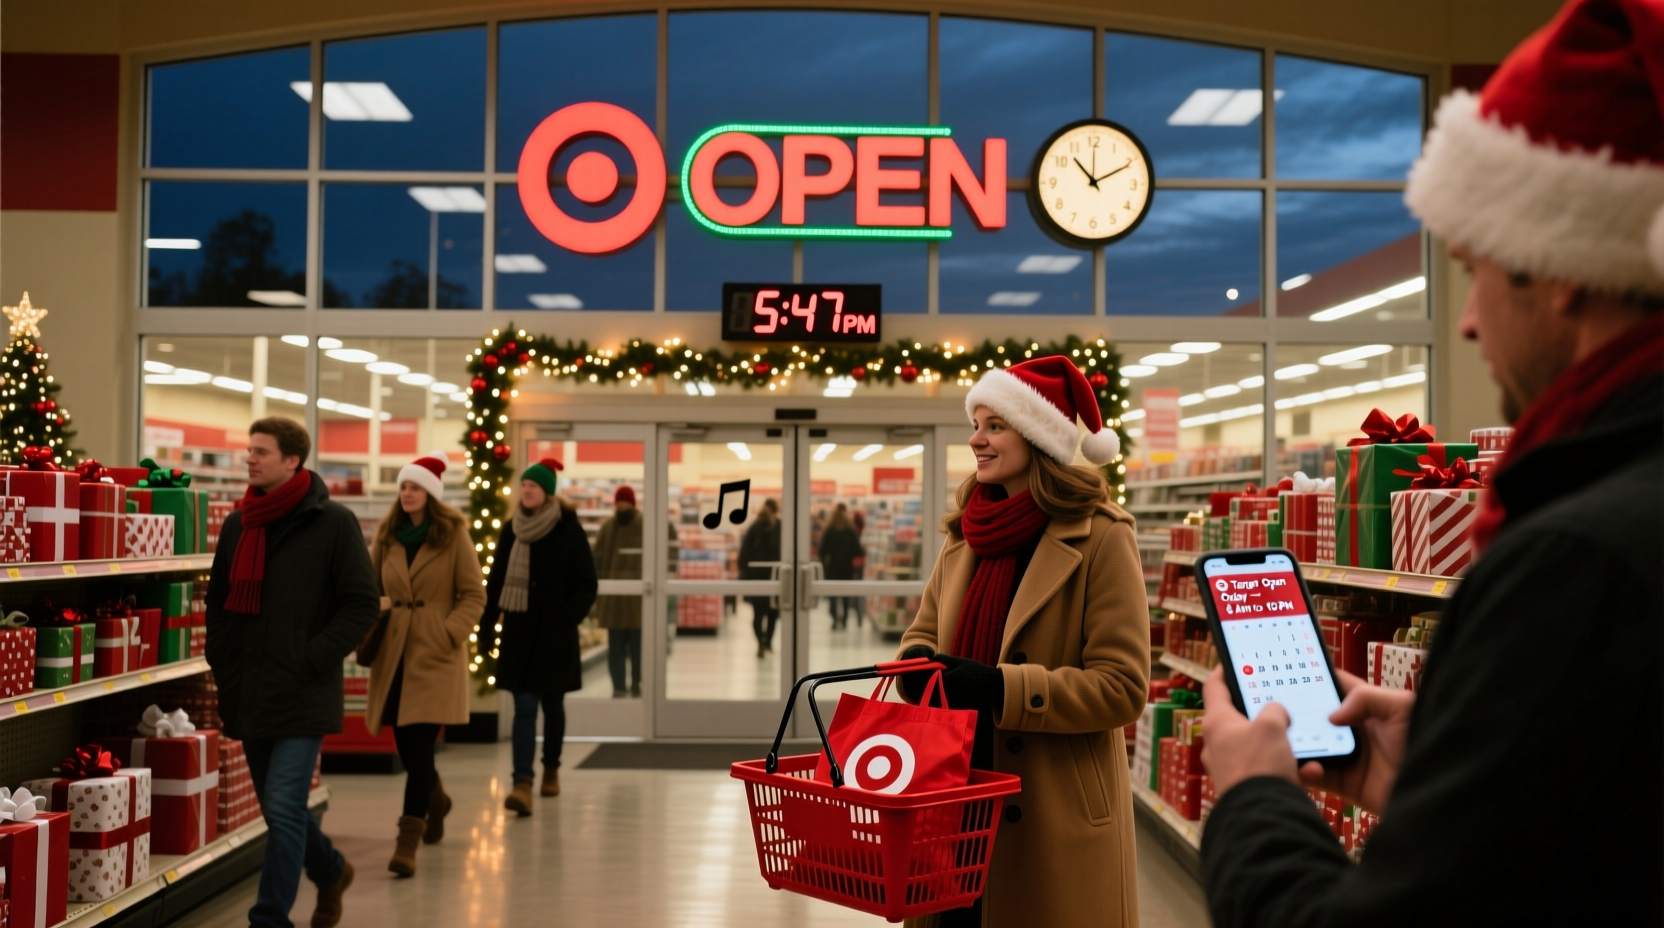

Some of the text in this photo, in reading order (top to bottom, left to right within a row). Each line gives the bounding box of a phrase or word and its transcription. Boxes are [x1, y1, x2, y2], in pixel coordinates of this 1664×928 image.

[1070, 142, 1079, 154] 11
[1088, 136, 1101, 148] 12
[1055, 156, 1068, 168] 10
[690, 131, 1007, 228] OPEN
[1049, 177, 1057, 189] 9
[1129, 179, 1138, 191] 3
[1055, 198, 1064, 210] 8
[1123, 200, 1131, 211] 4
[1070, 212, 1078, 224] 7
[1089, 217, 1098, 229] 6
[1109, 213, 1117, 225] 5
[753, 290, 876, 335] 5:47 PM
